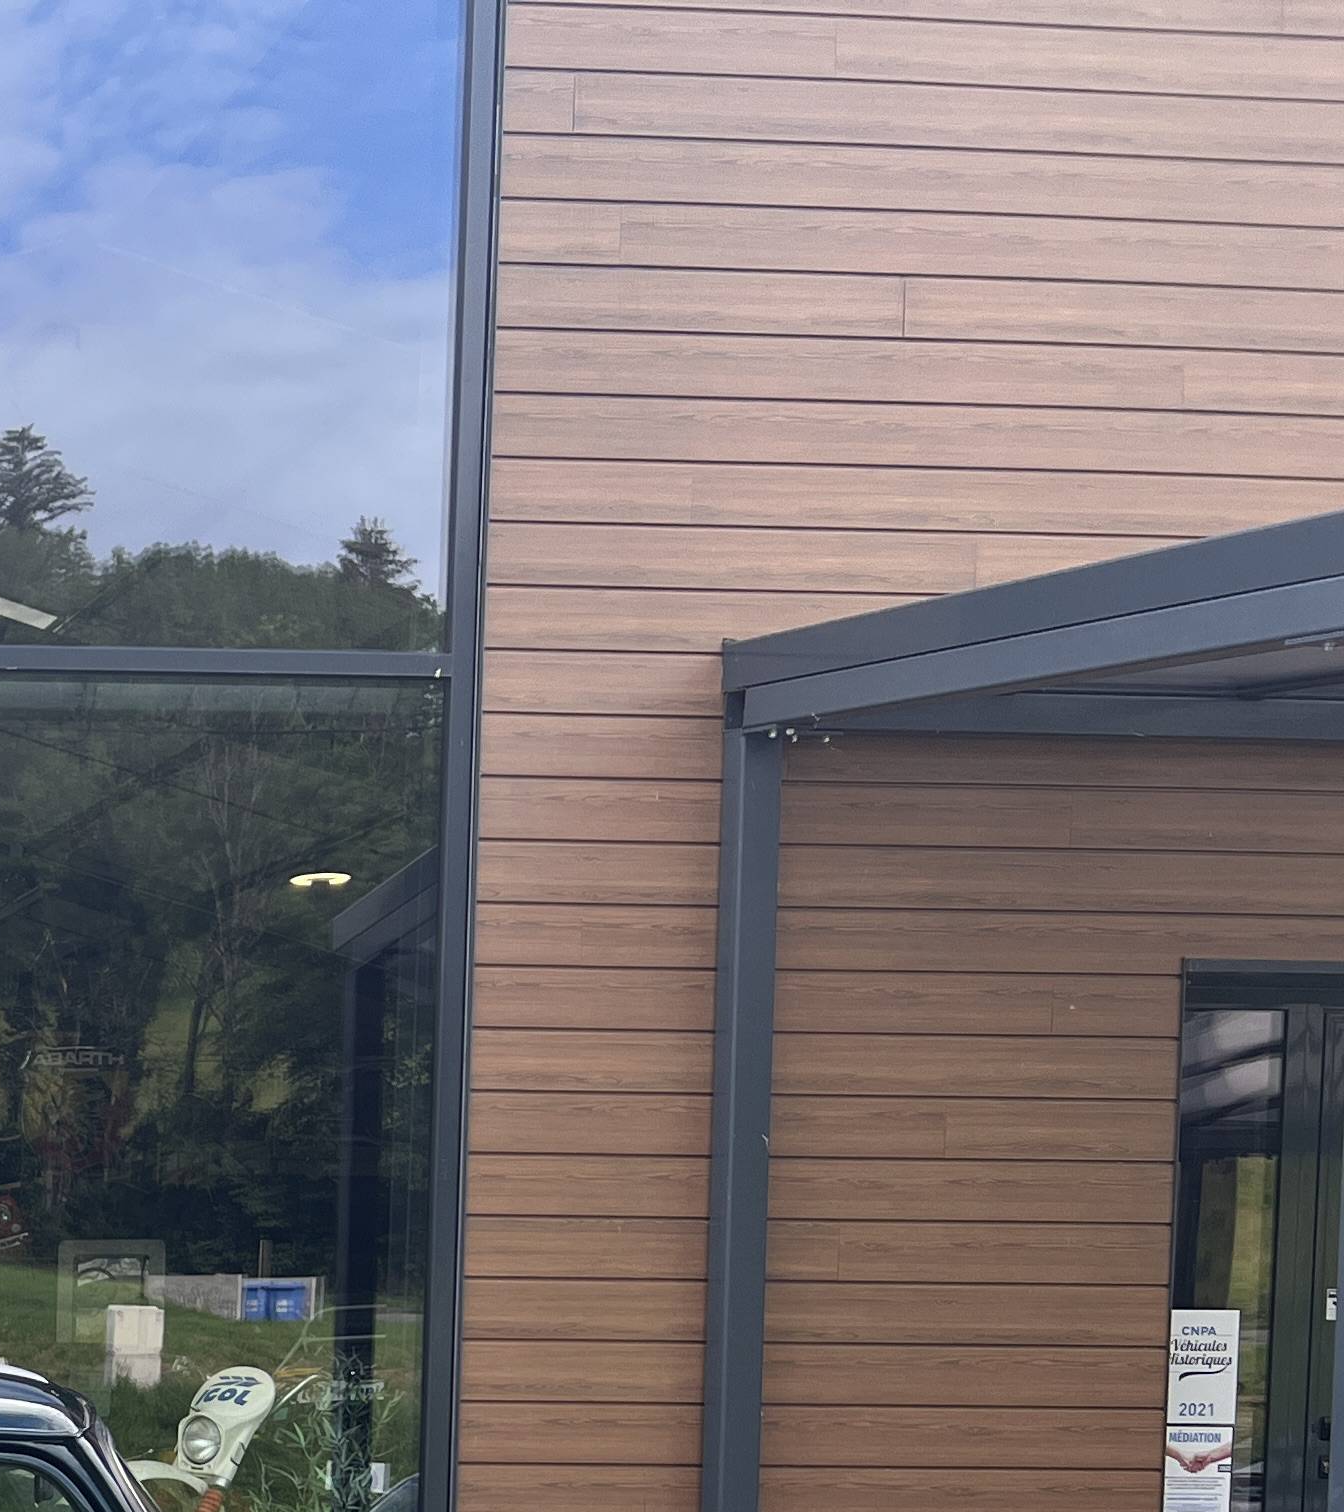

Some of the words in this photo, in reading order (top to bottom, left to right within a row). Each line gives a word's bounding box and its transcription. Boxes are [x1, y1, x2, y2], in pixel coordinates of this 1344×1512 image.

[1181, 1326, 1217, 1336] CNPA
[194, 1387, 252, 1406] IGOL
[1179, 1402, 1214, 1417] 2021
[1169, 1429, 1222, 1443] MÉDIATION
